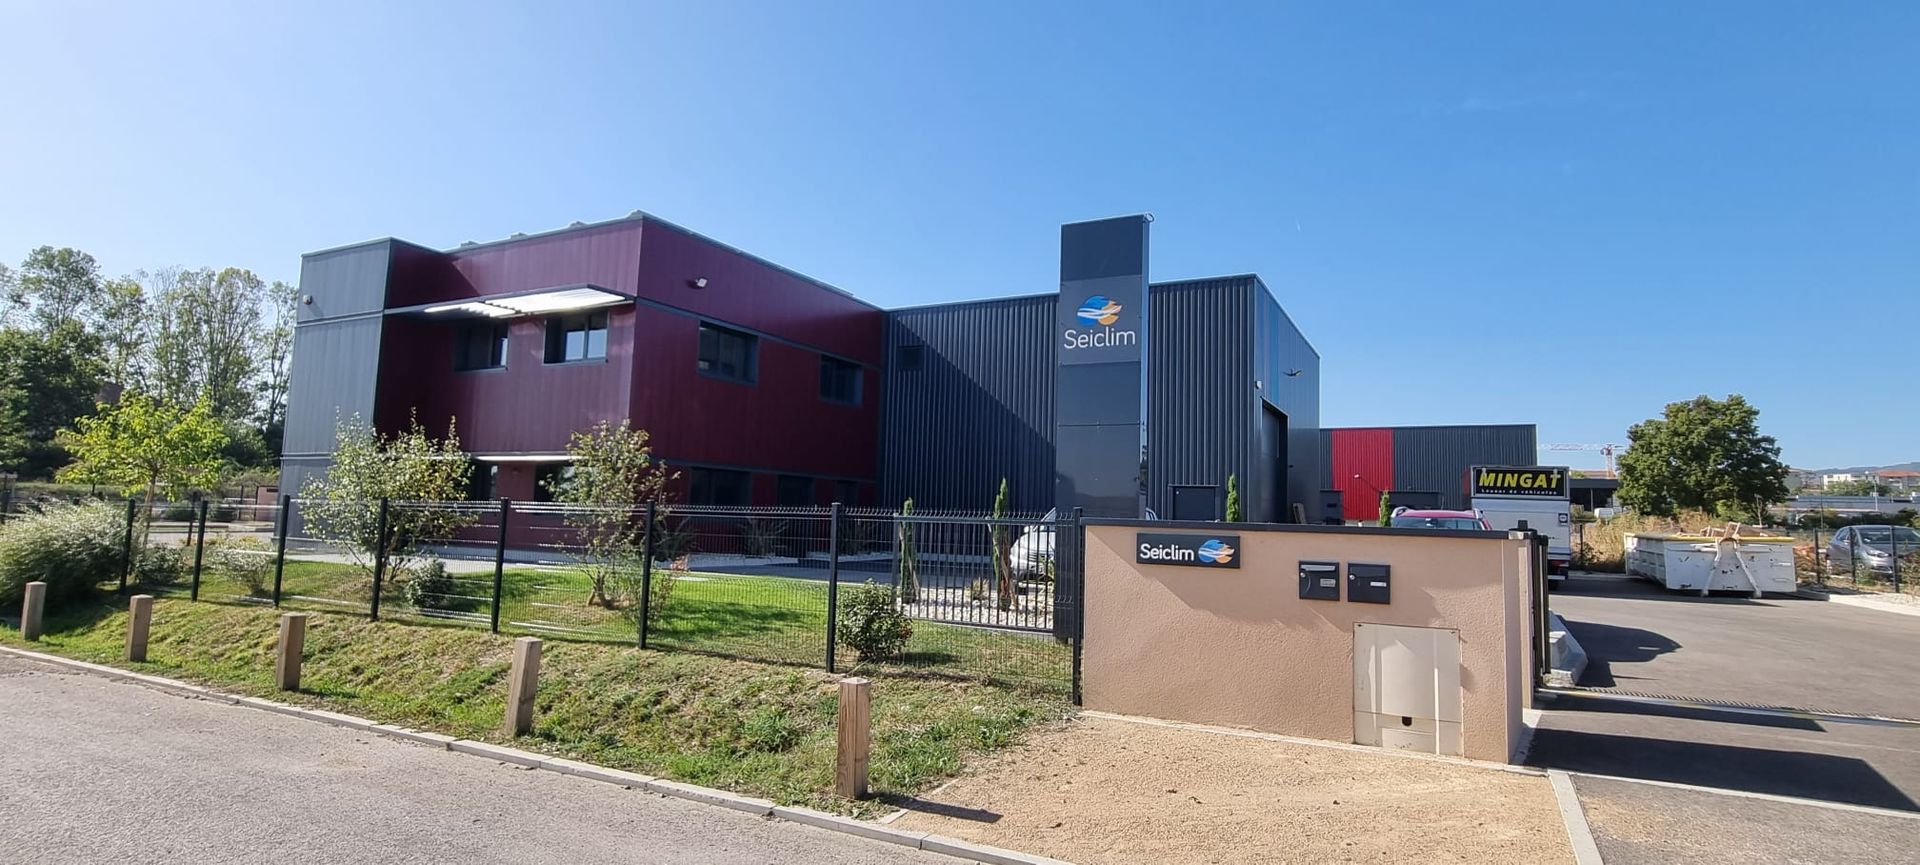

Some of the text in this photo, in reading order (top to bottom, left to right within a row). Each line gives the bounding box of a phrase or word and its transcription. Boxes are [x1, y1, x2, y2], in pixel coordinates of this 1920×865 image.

[1063, 326, 1136, 349] Seiclim
[1479, 472, 1561, 489] MINGAT
[1140, 543, 1195, 561] Seiclim
